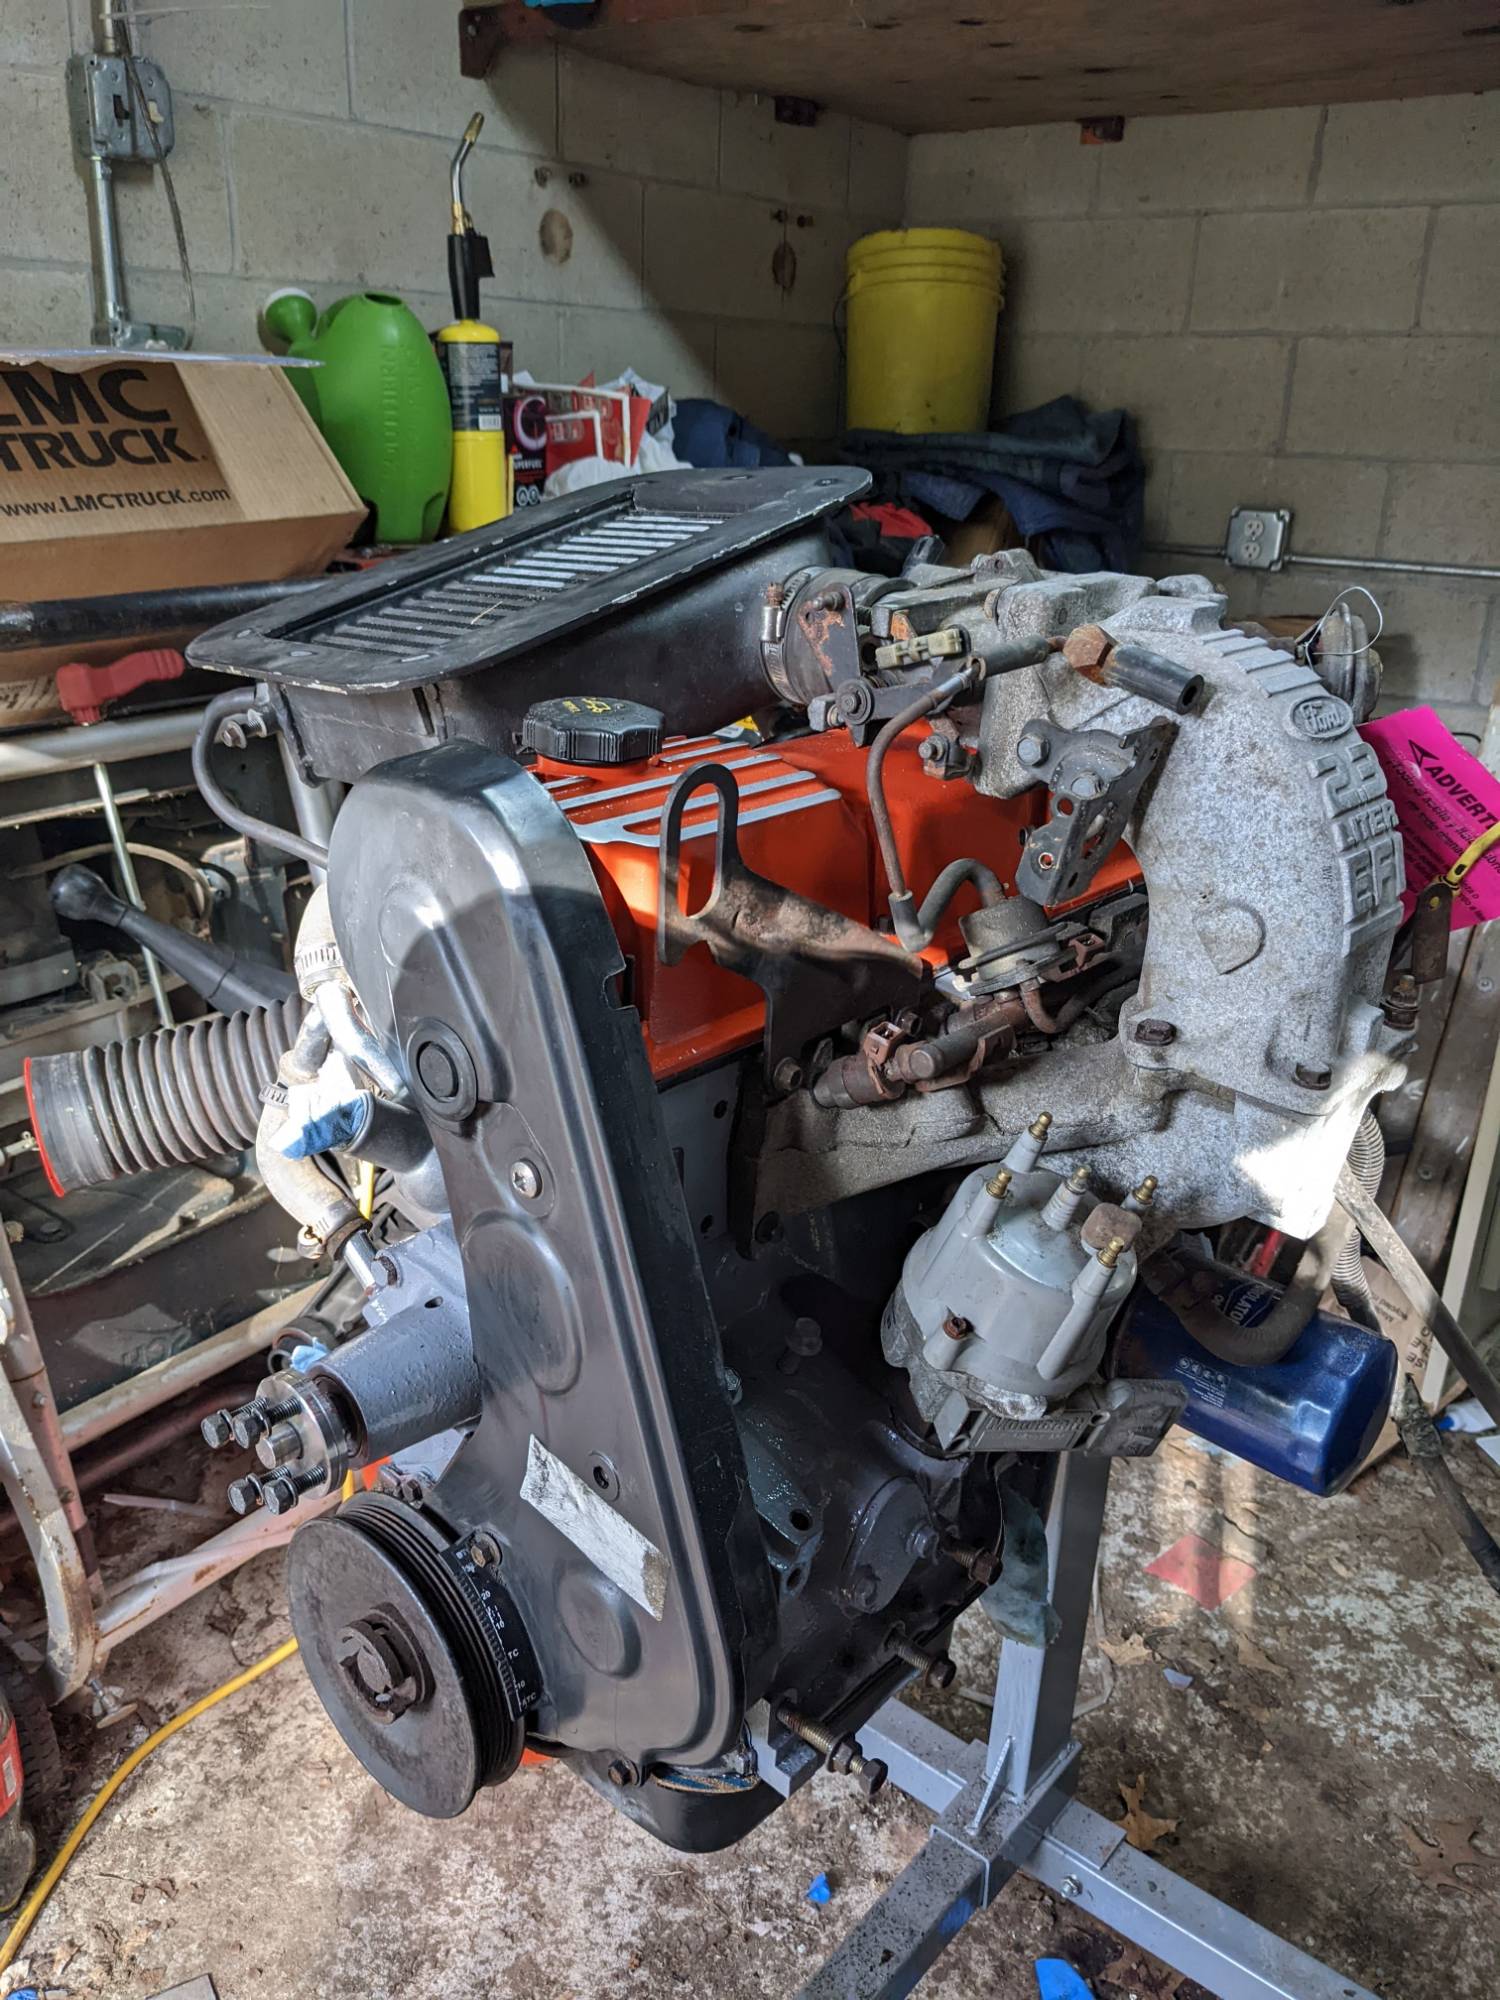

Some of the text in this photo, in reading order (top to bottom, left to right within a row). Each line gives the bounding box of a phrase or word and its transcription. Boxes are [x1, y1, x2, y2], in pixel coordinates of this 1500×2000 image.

[1332, 799, 1400, 852] LITER
[481, 1589, 491, 1600] 20
[496, 1620, 506, 1630] 10
[507, 1648, 520, 1660] TC
